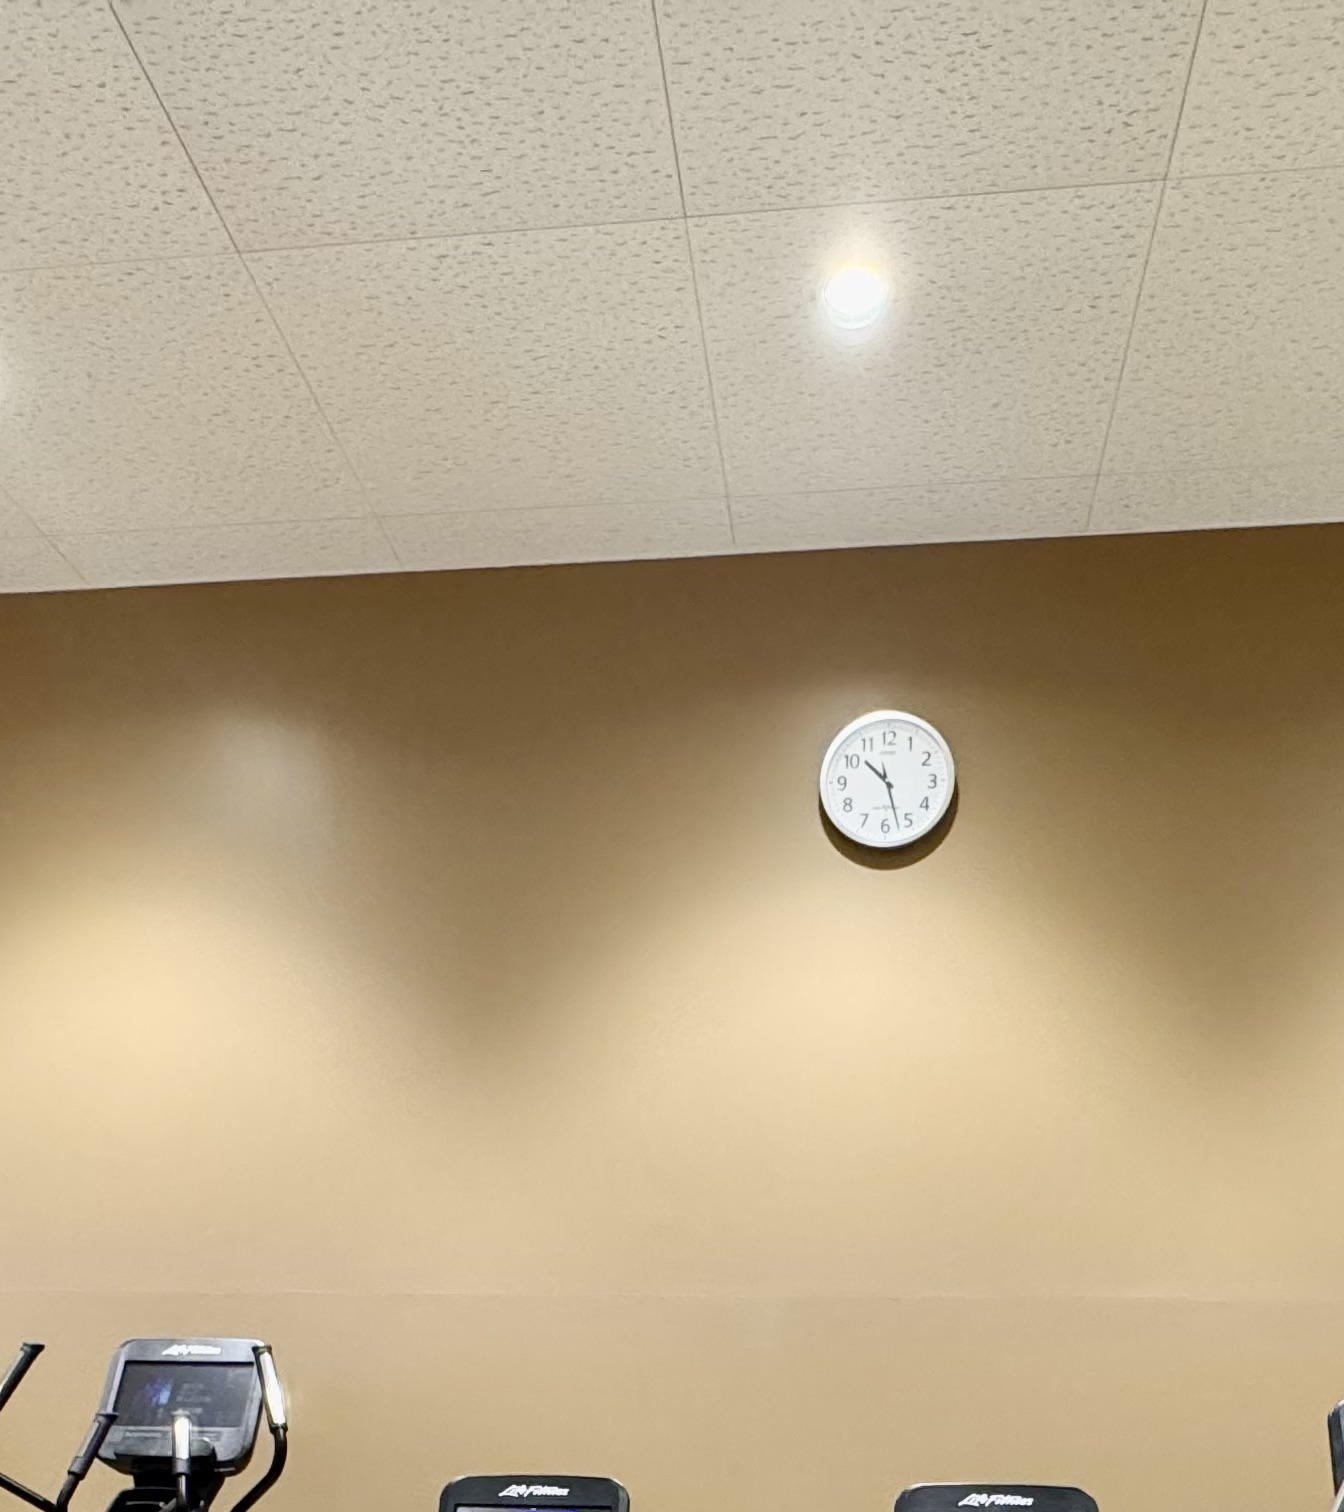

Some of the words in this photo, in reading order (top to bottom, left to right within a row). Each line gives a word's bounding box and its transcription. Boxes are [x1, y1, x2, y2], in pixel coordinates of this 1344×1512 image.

[861, 737, 873, 752] 11
[881, 730, 896, 746] 12
[908, 736, 913, 751] 1
[844, 754, 860, 769] 10
[921, 752, 931, 766] 2
[837, 776, 847, 791] 9
[928, 774, 937, 789] 3
[843, 797, 853, 812] 8
[919, 796, 929, 811] 4
[860, 813, 869, 828] 7
[881, 818, 890, 833] 6
[904, 813, 913, 828] 5
